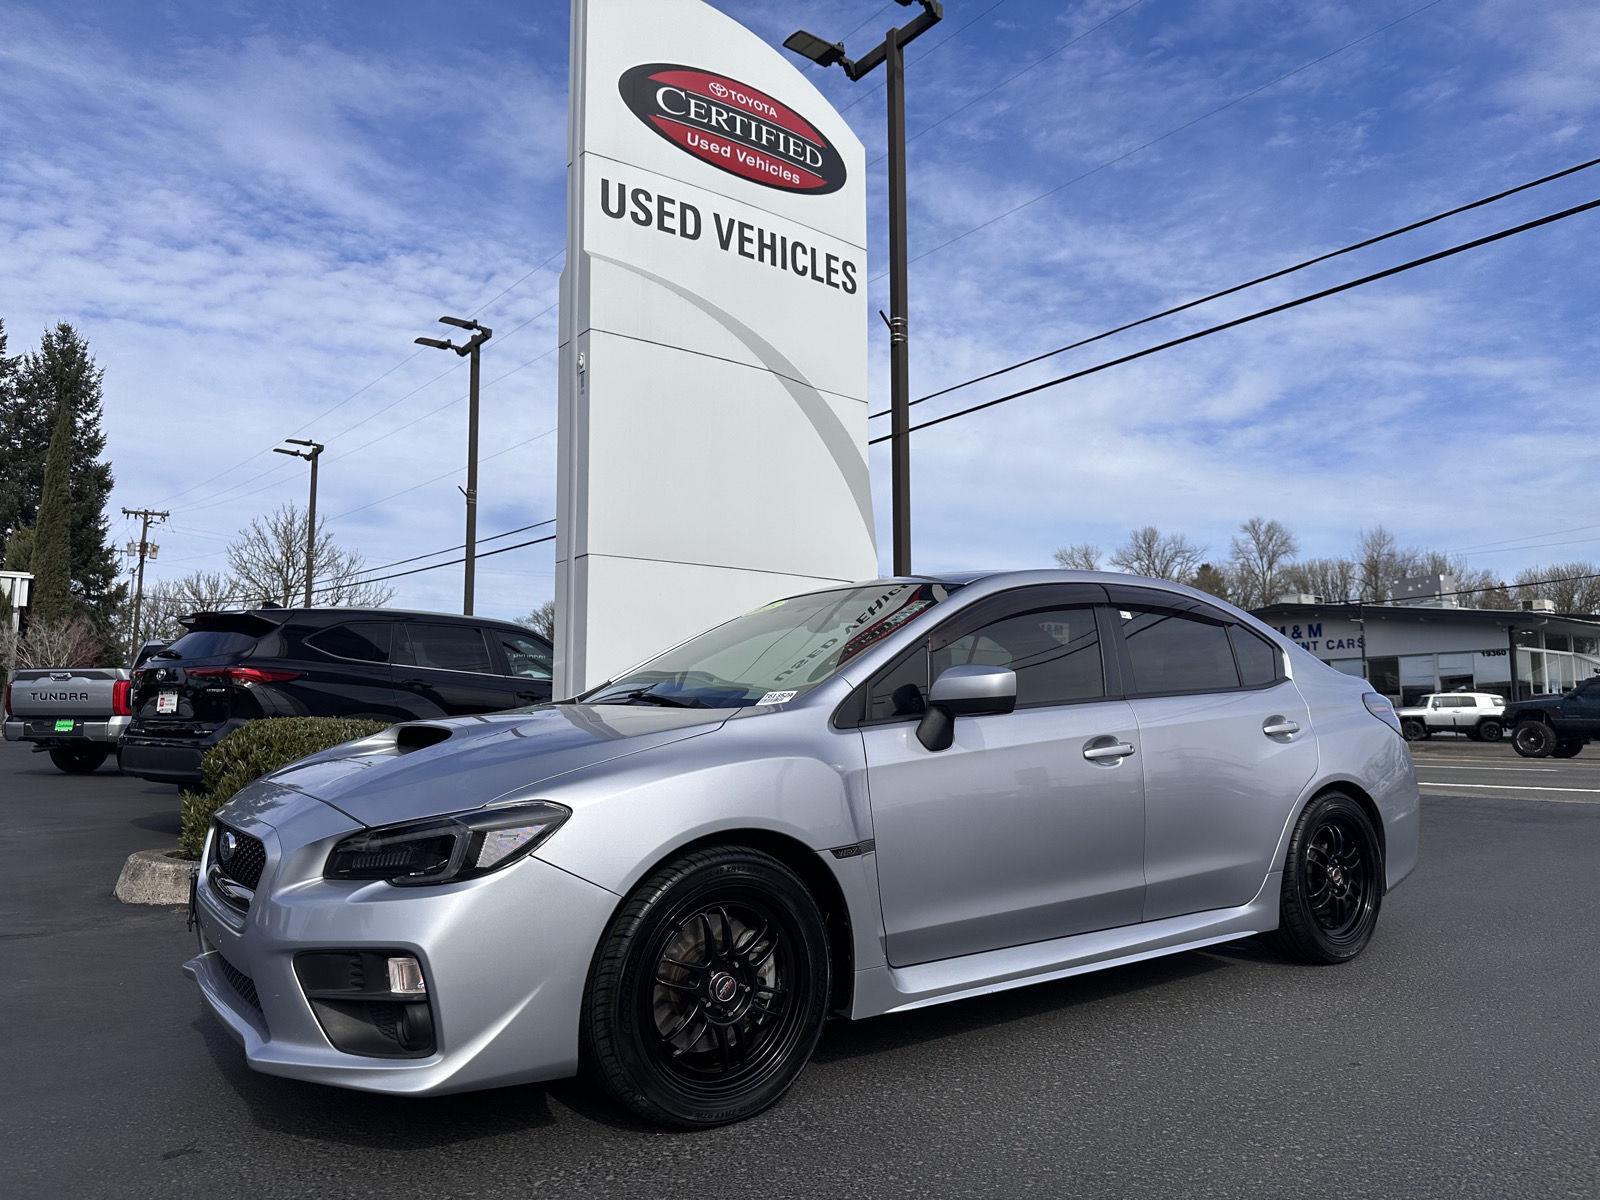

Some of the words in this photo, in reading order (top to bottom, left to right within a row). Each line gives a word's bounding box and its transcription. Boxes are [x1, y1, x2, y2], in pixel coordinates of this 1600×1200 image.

[729, 90, 777, 119] TOYOTA
[656, 86, 823, 168] CERTIFIED
[687, 132, 731, 158] Used
[736, 148, 801, 185] Vehicles
[601, 178, 702, 241] USED
[713, 212, 857, 295] VEHICLES
[1291, 624, 1302, 639] &
[1308, 623, 1322, 638] M
[1326, 637, 1366, 650] CARS
[30, 692, 89, 701] TUNDRA
